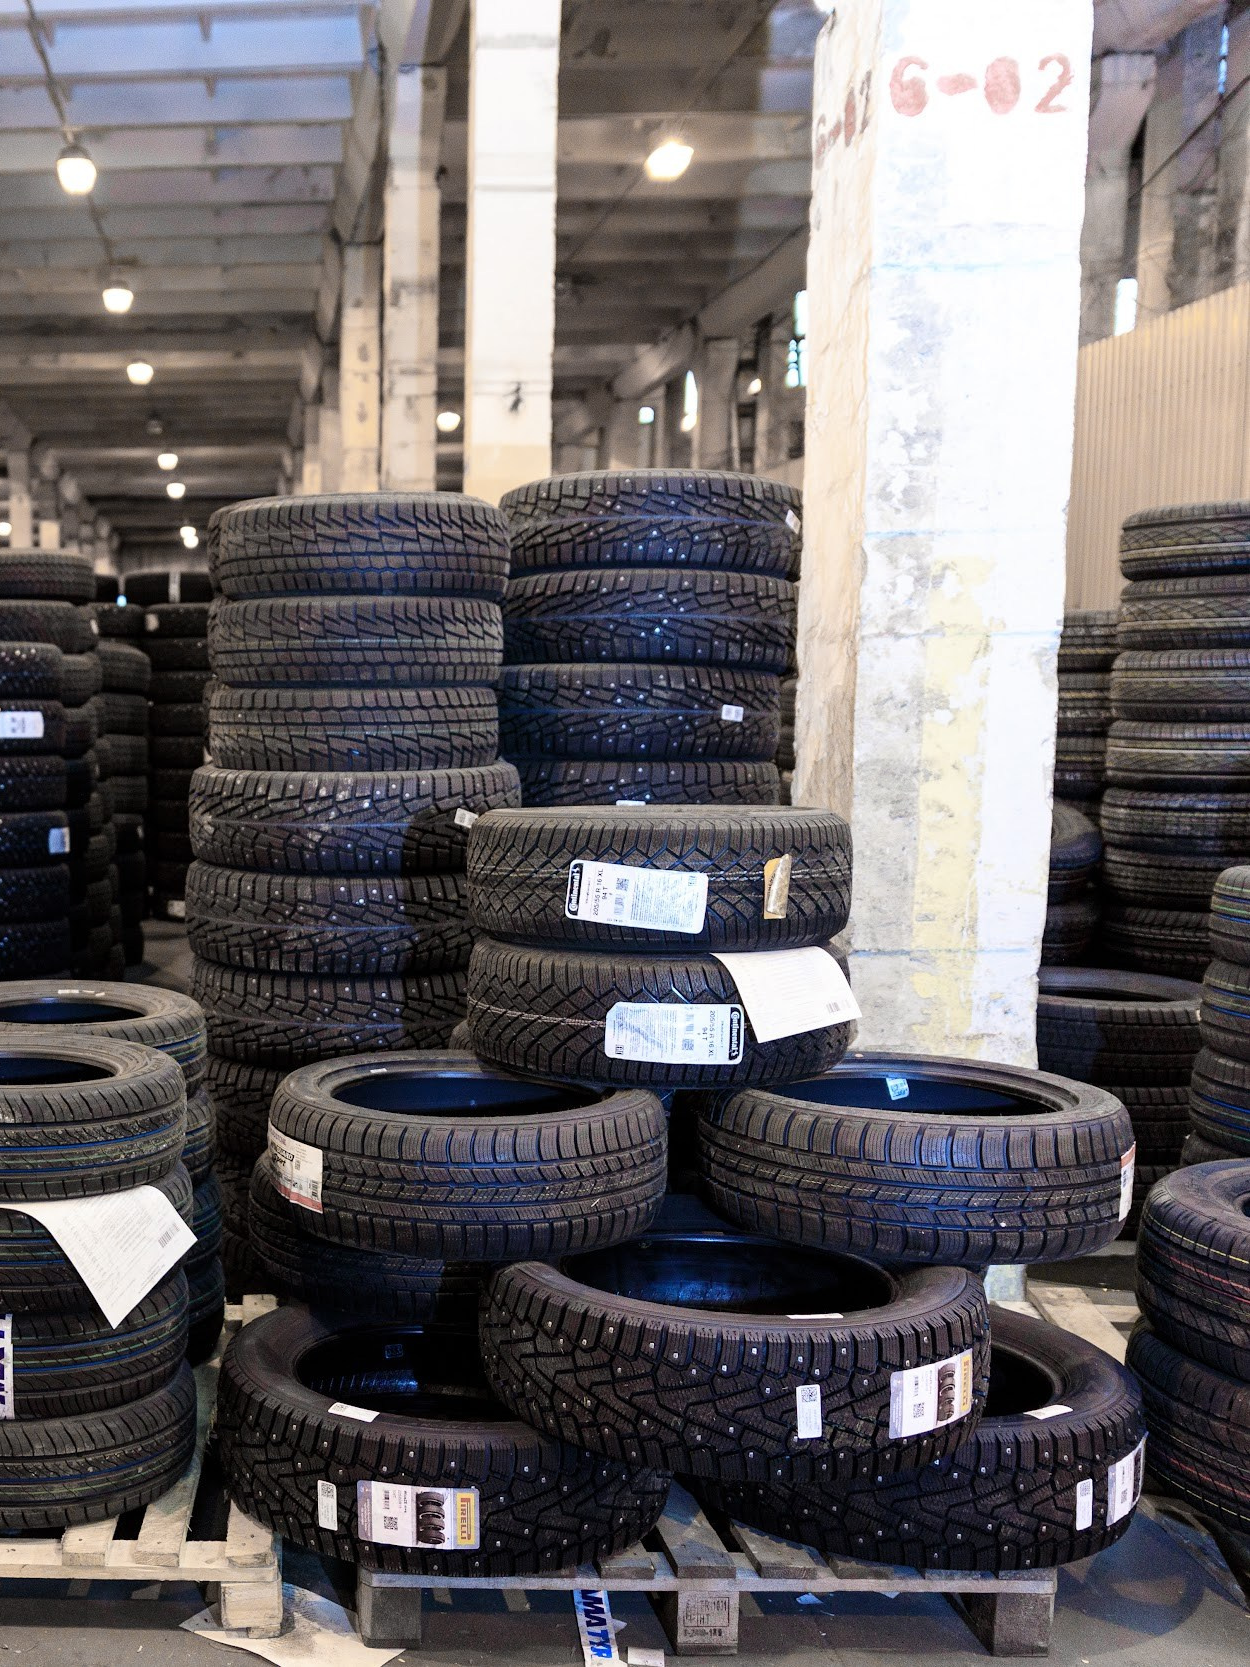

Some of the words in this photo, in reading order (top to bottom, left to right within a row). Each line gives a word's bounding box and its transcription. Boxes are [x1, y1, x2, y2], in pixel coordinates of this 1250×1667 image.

[889, 52, 1074, 117] 6-02
[569, 873, 580, 911] Continental
[731, 1011, 740, 1050] Continental
[460, 1497, 472, 1540] PIRELLI
